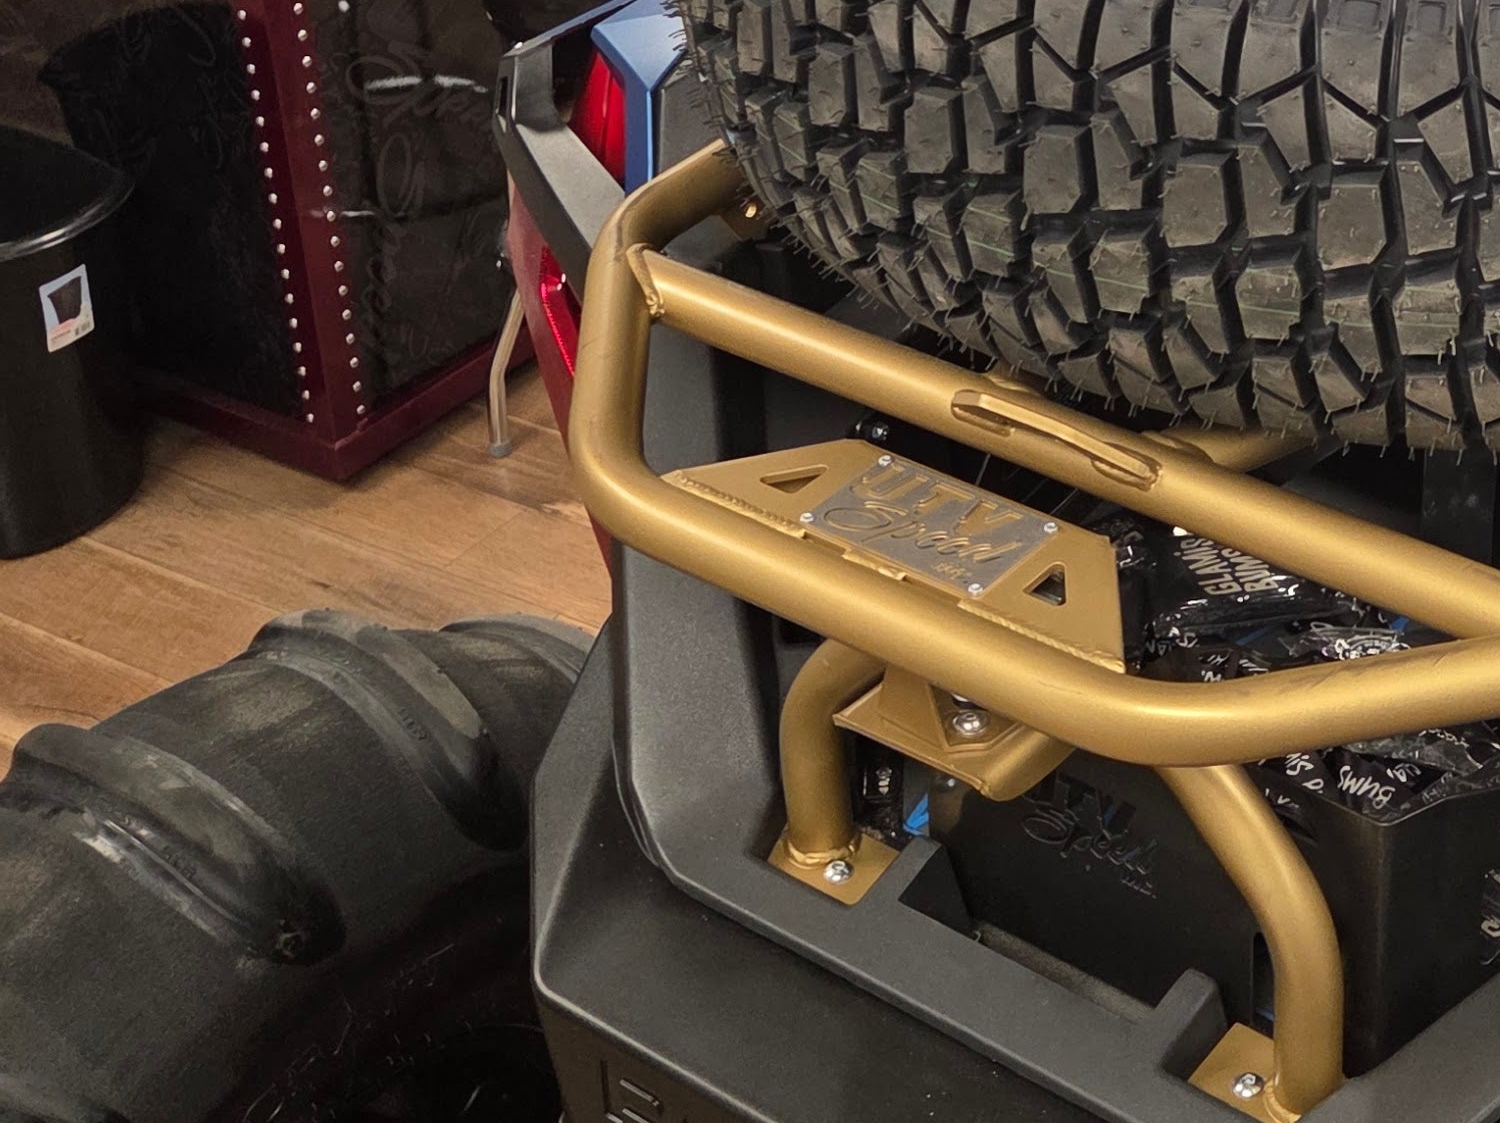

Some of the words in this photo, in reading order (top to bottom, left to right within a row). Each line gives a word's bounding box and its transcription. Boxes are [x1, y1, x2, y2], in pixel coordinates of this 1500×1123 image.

[850, 460, 1024, 537] UTV
[823, 500, 1023, 565] Speed
[1220, 547, 1280, 592] BUMS
[1337, 765, 1396, 810] BUMS
